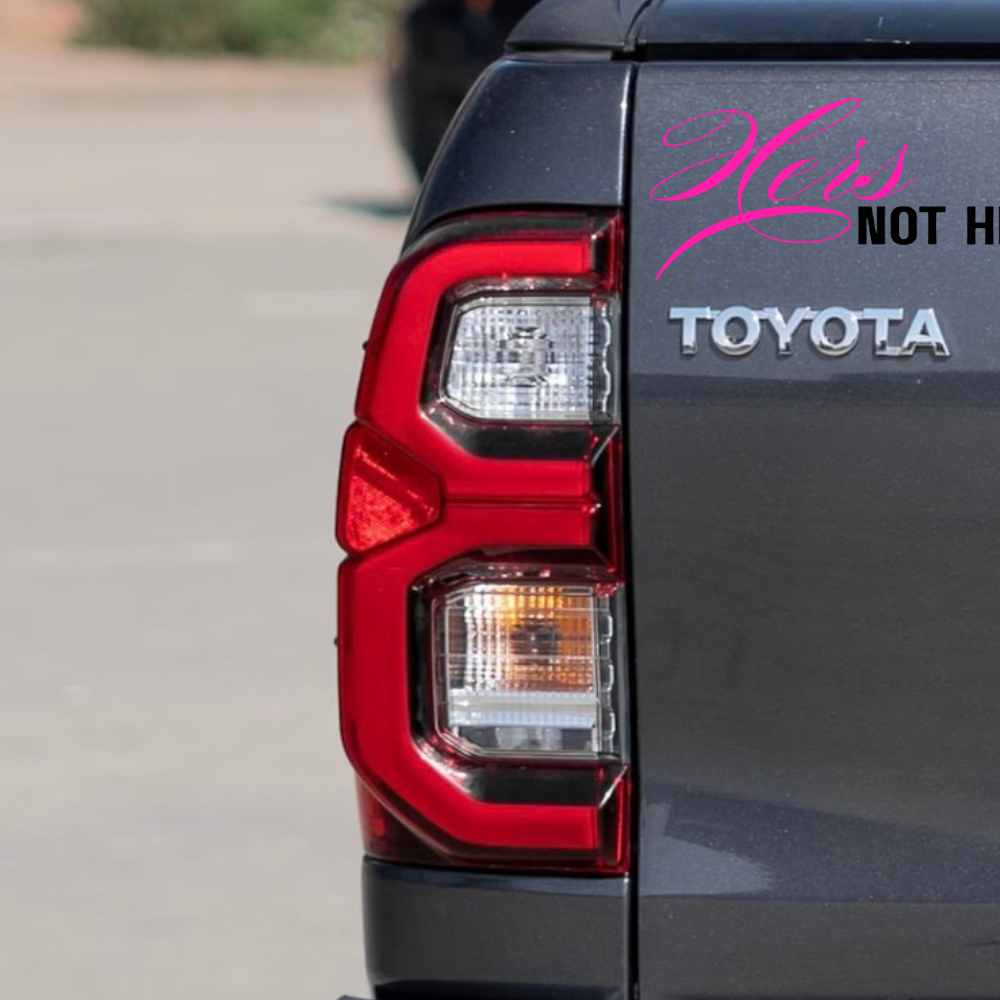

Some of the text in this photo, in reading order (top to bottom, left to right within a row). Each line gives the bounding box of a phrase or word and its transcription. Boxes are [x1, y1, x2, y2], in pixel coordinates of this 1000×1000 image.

[650, 98, 918, 280] Hers
[858, 206, 946, 245] NOT
[669, 306, 950, 356] TOYOTA
